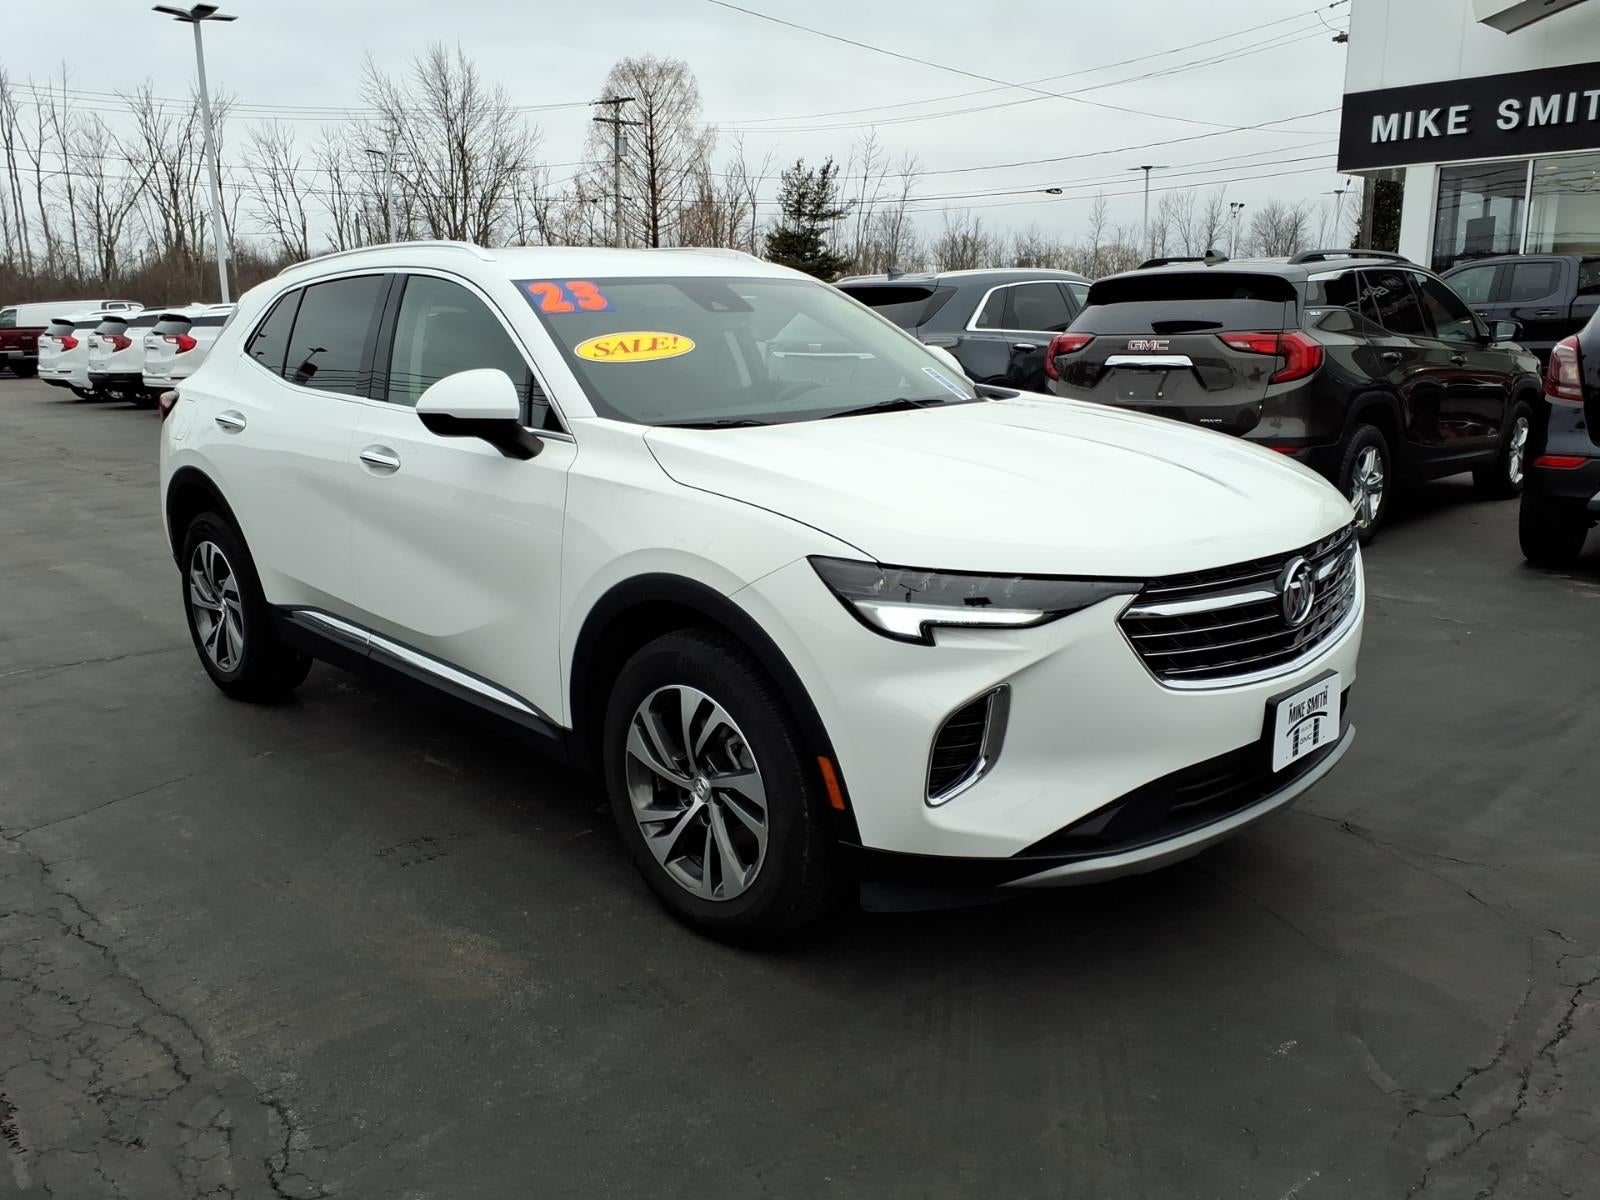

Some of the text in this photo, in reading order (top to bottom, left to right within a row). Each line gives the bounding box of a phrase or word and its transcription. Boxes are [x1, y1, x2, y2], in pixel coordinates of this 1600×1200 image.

[1371, 105, 1470, 143] MIKE
[528, 281, 608, 313] 23
[593, 336, 679, 358] SALE!
[1128, 340, 1169, 351] GMC
[1288, 690, 1328, 725] MIKE SMITH
